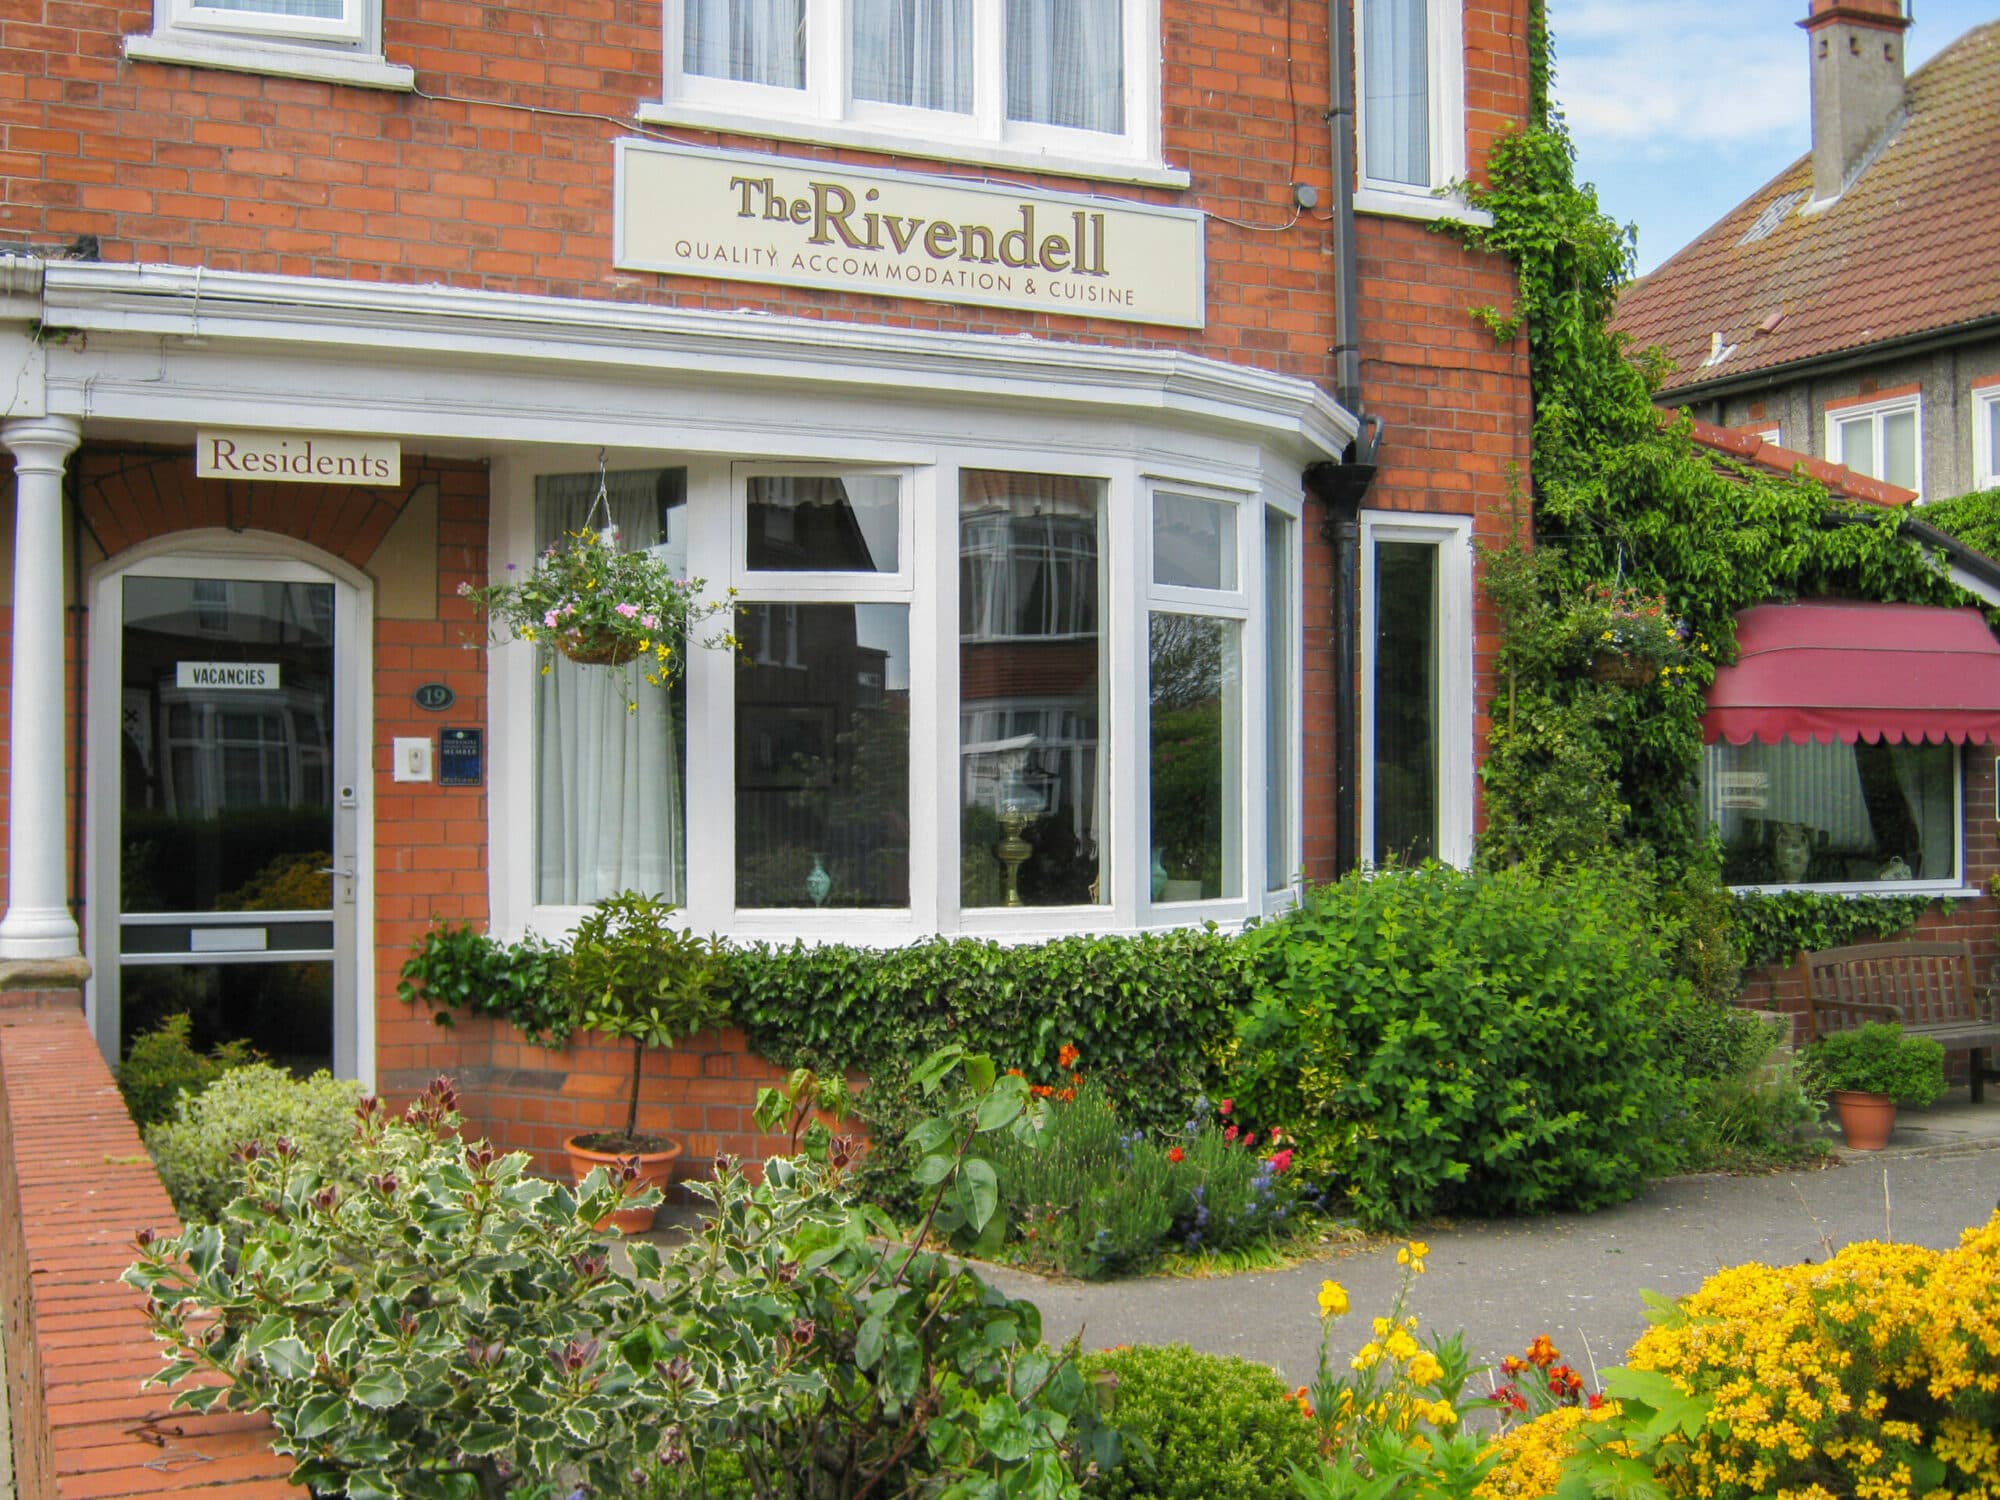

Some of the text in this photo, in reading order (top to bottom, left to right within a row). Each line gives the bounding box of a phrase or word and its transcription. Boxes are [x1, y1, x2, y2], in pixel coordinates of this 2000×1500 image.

[730, 176, 1110, 277] The Rivendell
[674, 239, 1135, 306] QUALITY ACCOMMODATION & CUISINE
[210, 438, 390, 478] Residents
[193, 668, 265, 686] VACANCIES
[424, 689, 447, 705] 19
